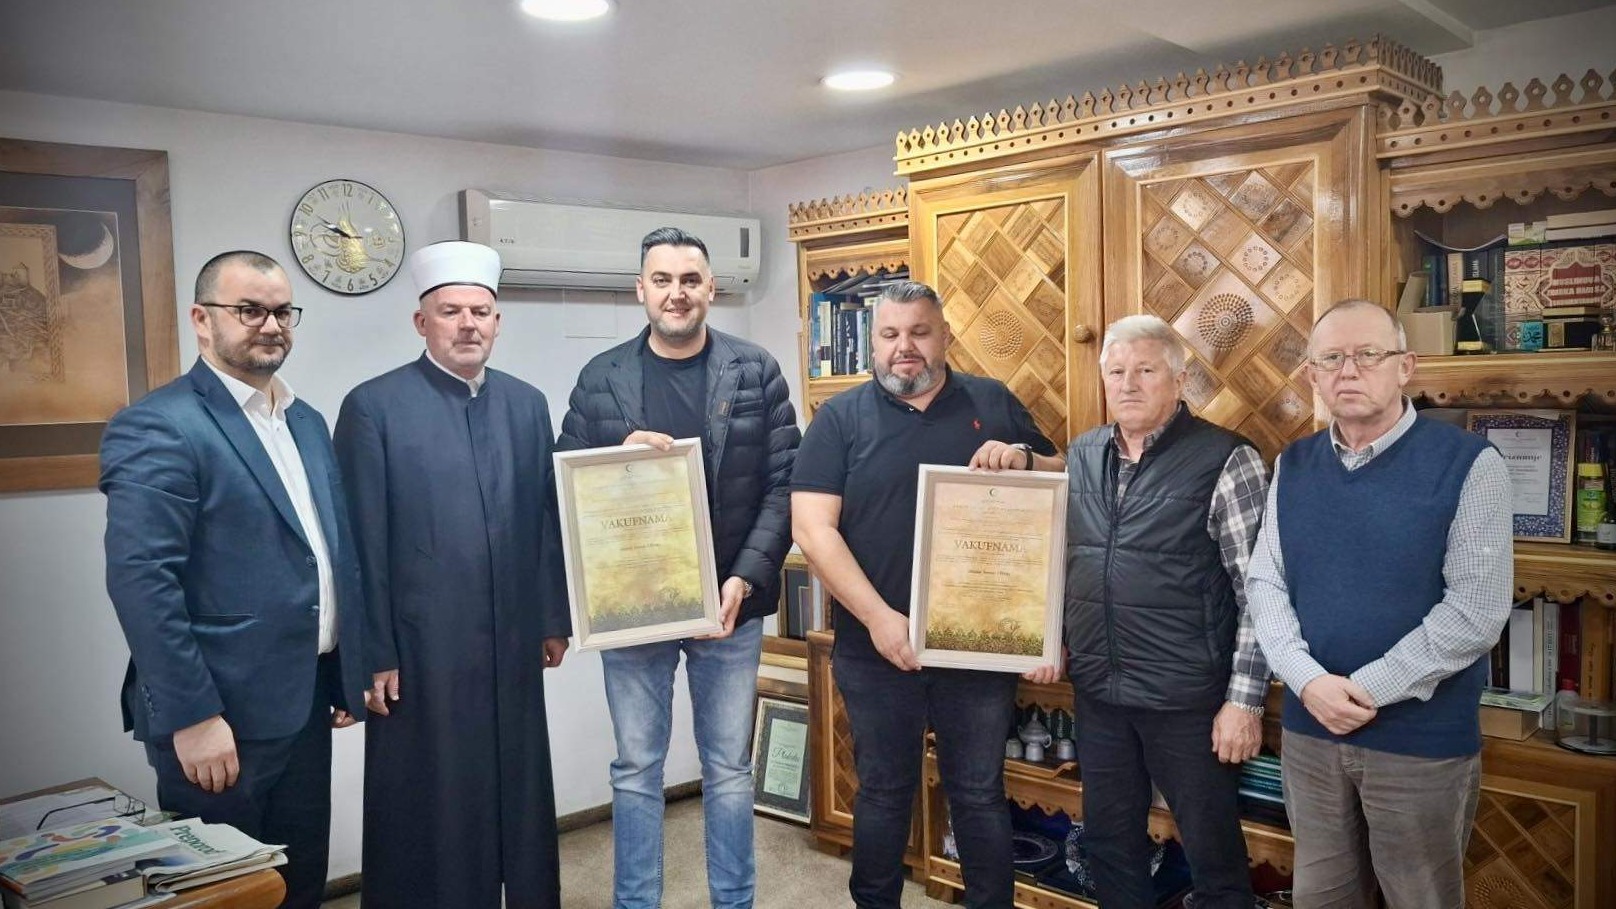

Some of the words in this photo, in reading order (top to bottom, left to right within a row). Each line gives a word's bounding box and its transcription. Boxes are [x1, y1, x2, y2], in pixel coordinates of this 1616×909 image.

[318, 188, 330, 202] 11
[341, 183, 353, 197] 12
[298, 203, 314, 216] 10
[301, 254, 314, 264] 8
[322, 270, 331, 283] 7
[368, 274, 378, 286] 5
[347, 278, 354, 291] 6
[601, 514, 673, 530] VAKUFNAM
